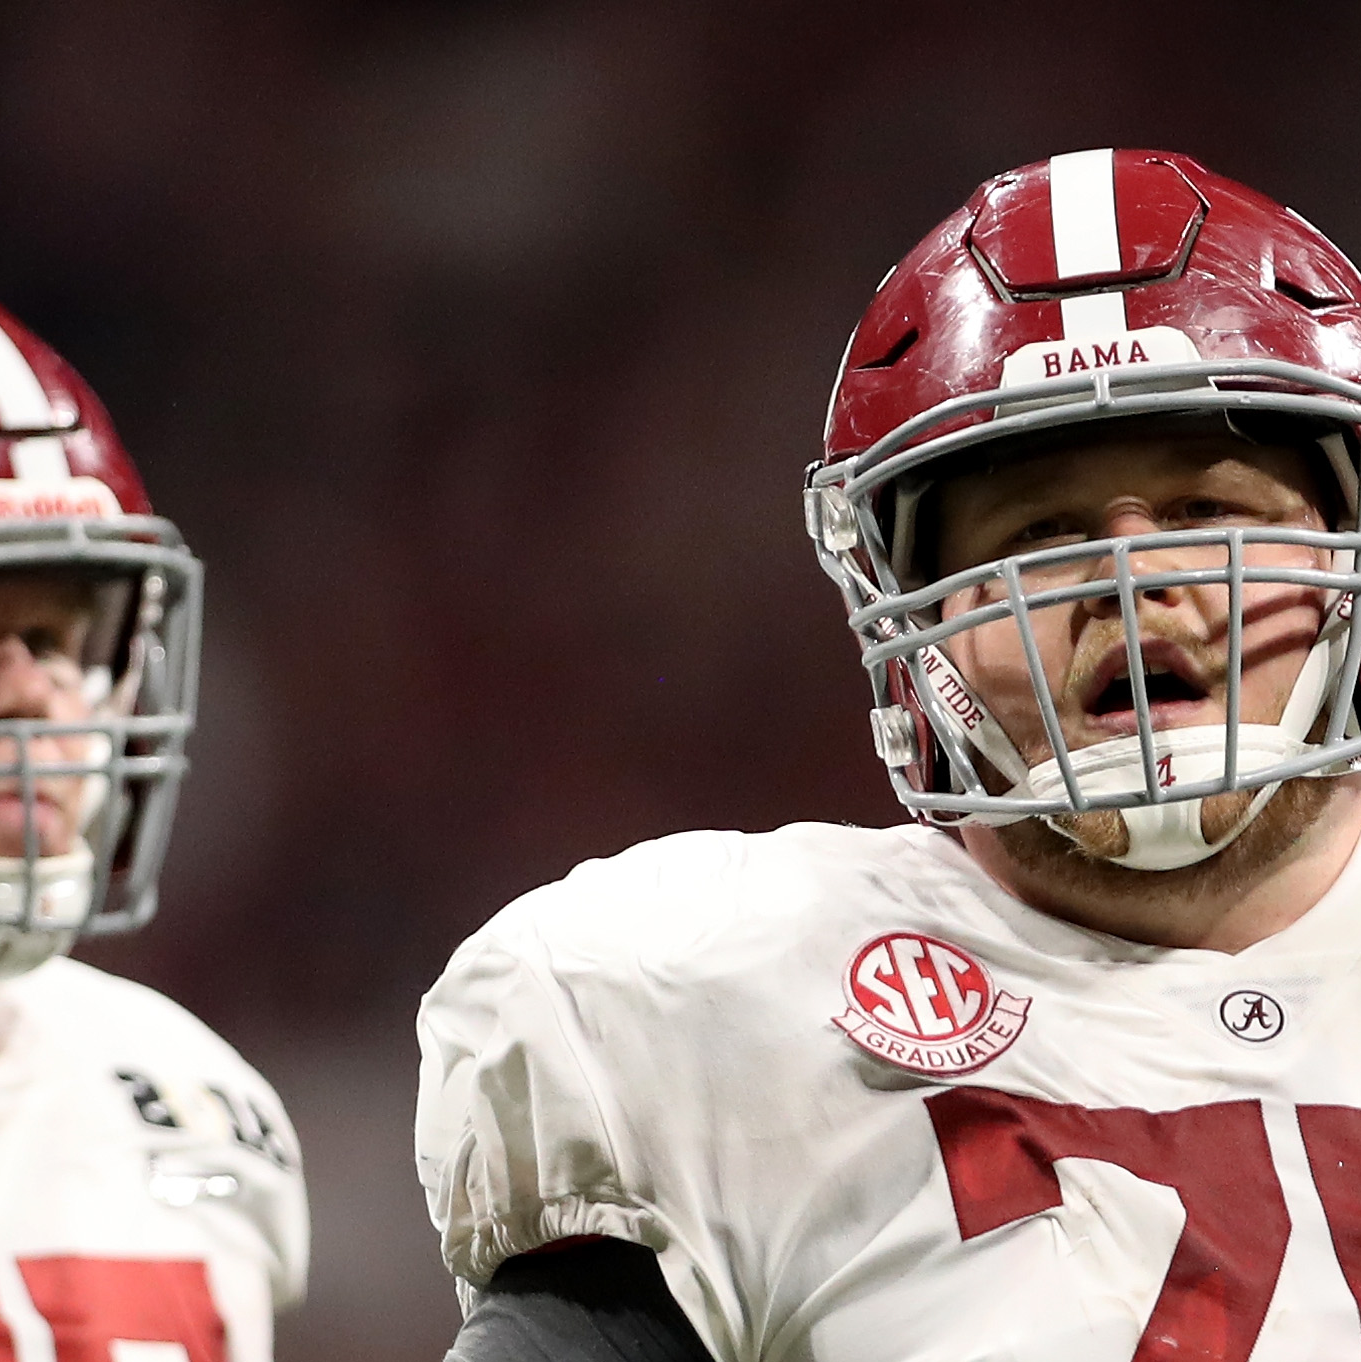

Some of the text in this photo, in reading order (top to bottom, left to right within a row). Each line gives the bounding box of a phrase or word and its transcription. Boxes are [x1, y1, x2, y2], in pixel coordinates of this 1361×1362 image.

[1043, 339, 1150, 378] BAMA
[937, 674, 986, 731] TIDE
[855, 937, 985, 1037] SEC
[1229, 993, 1275, 1034] A
[866, 1020, 1014, 1068] GRADUATE
